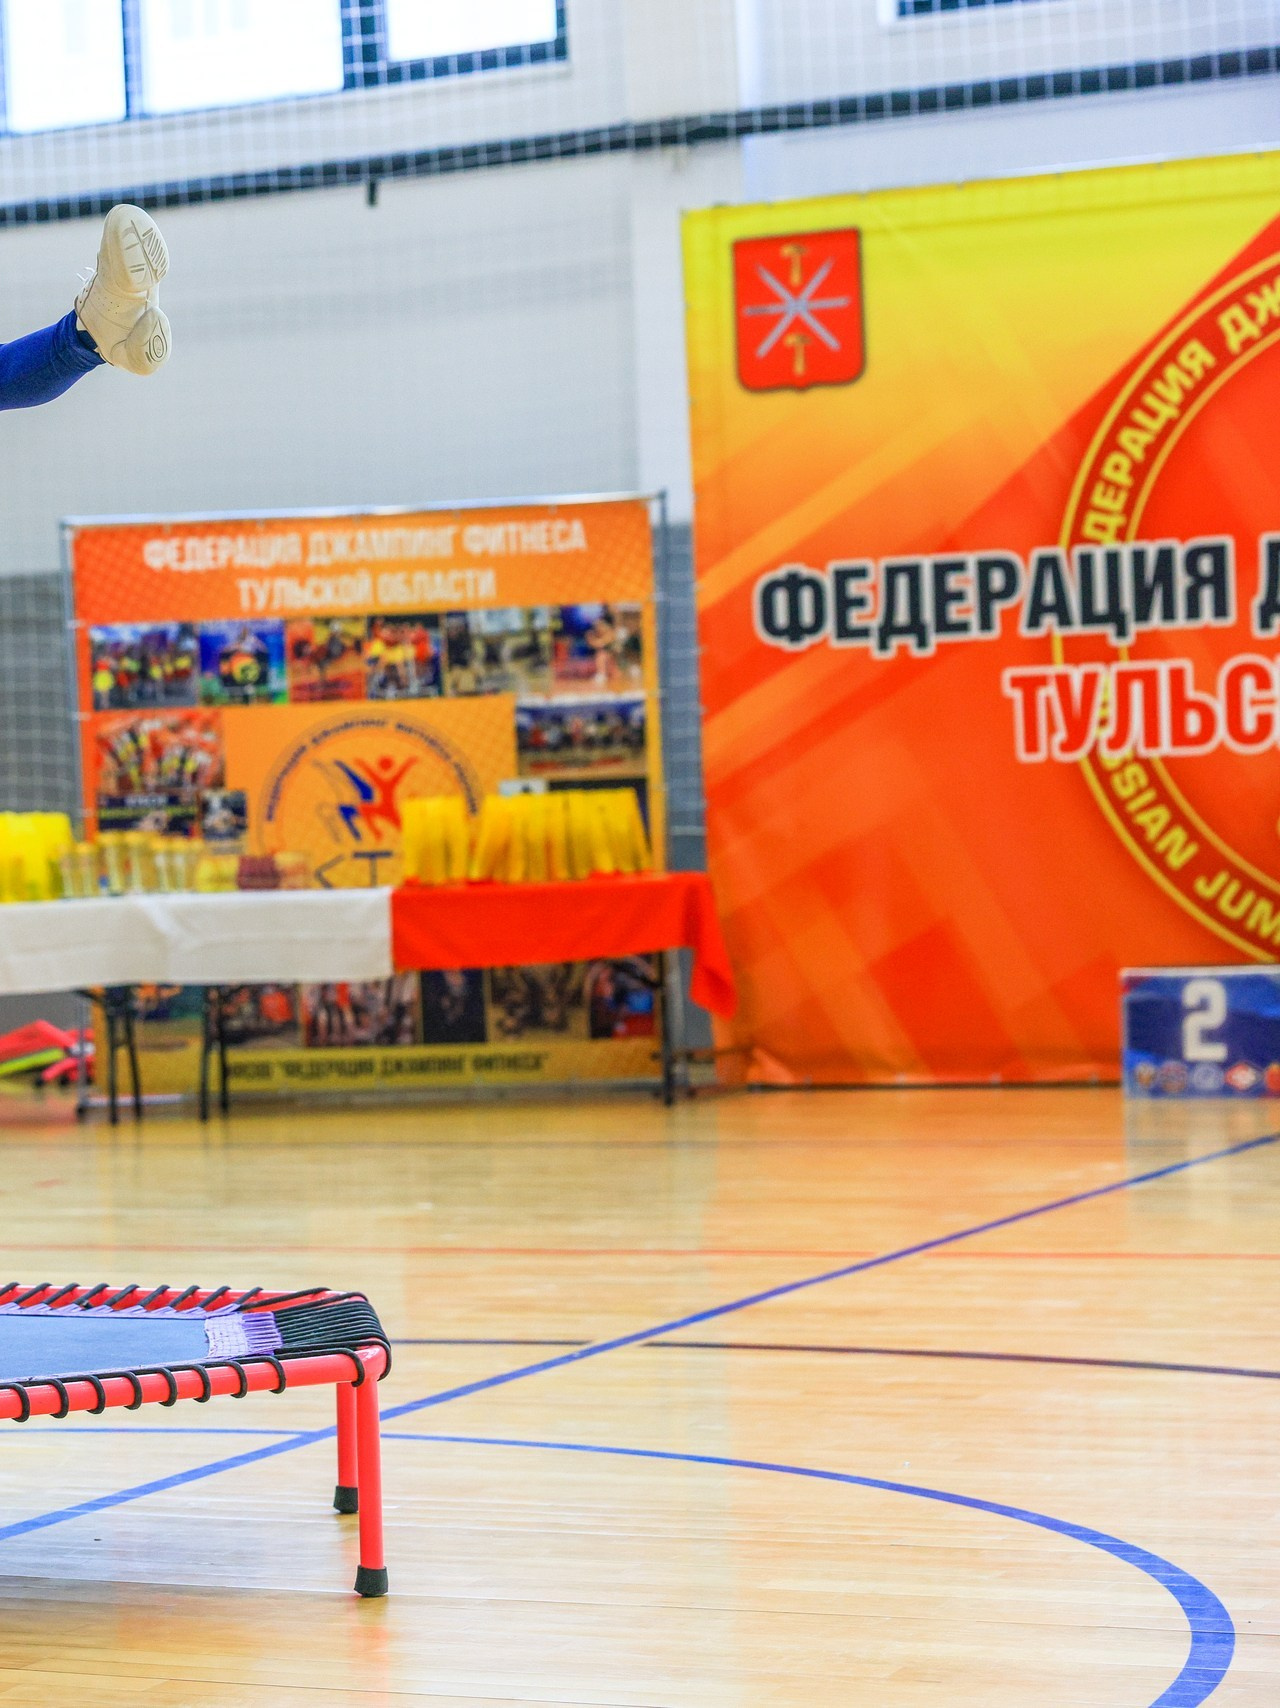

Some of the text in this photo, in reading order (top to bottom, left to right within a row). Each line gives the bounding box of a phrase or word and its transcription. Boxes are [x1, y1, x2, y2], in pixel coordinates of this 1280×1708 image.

[1081, 338, 1216, 546] ДЕРАЦИЯ
[143, 519, 587, 572] ФЕДЕРАЦИЯ ДЖАМПИНГ ФИТНЕСА
[237, 568, 497, 612] ТУЛЬСКОЙ ОБЛАСТИ
[756, 536, 1234, 655] ФЕДЕРАЦИЯ
[1002, 653, 1276, 763] ТУЛЬС
[1102, 750, 1198, 871] SIAN
[1182, 979, 1228, 1062] 2
